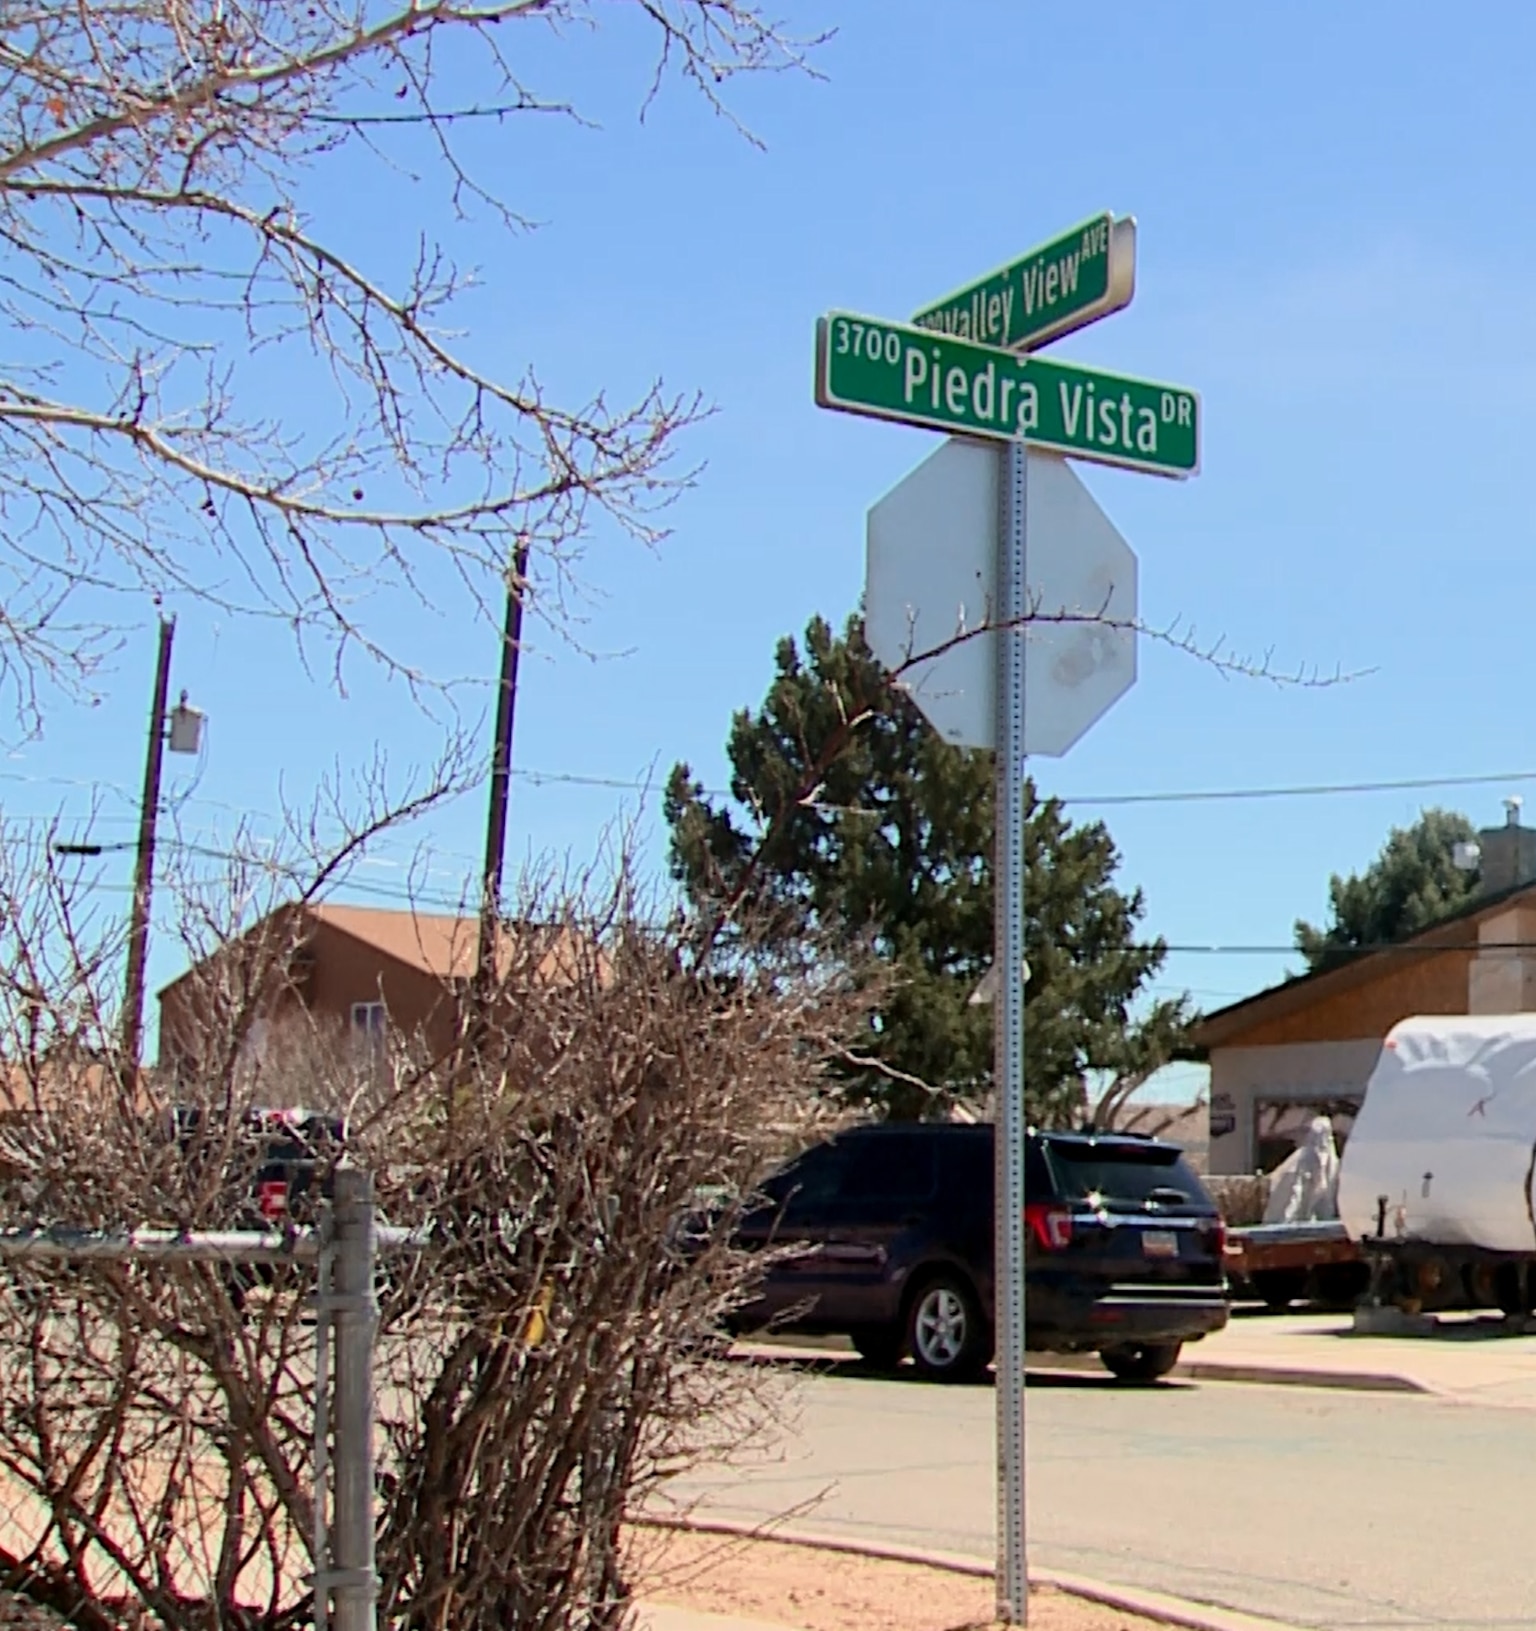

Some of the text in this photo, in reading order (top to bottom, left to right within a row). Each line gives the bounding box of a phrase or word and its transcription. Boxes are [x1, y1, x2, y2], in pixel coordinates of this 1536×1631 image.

[945, 285, 1014, 347] Valley
[1022, 252, 1080, 316] View
[1081, 222, 1108, 262] AVE
[836, 319, 1192, 453] 3700 Piedra Vista DR
